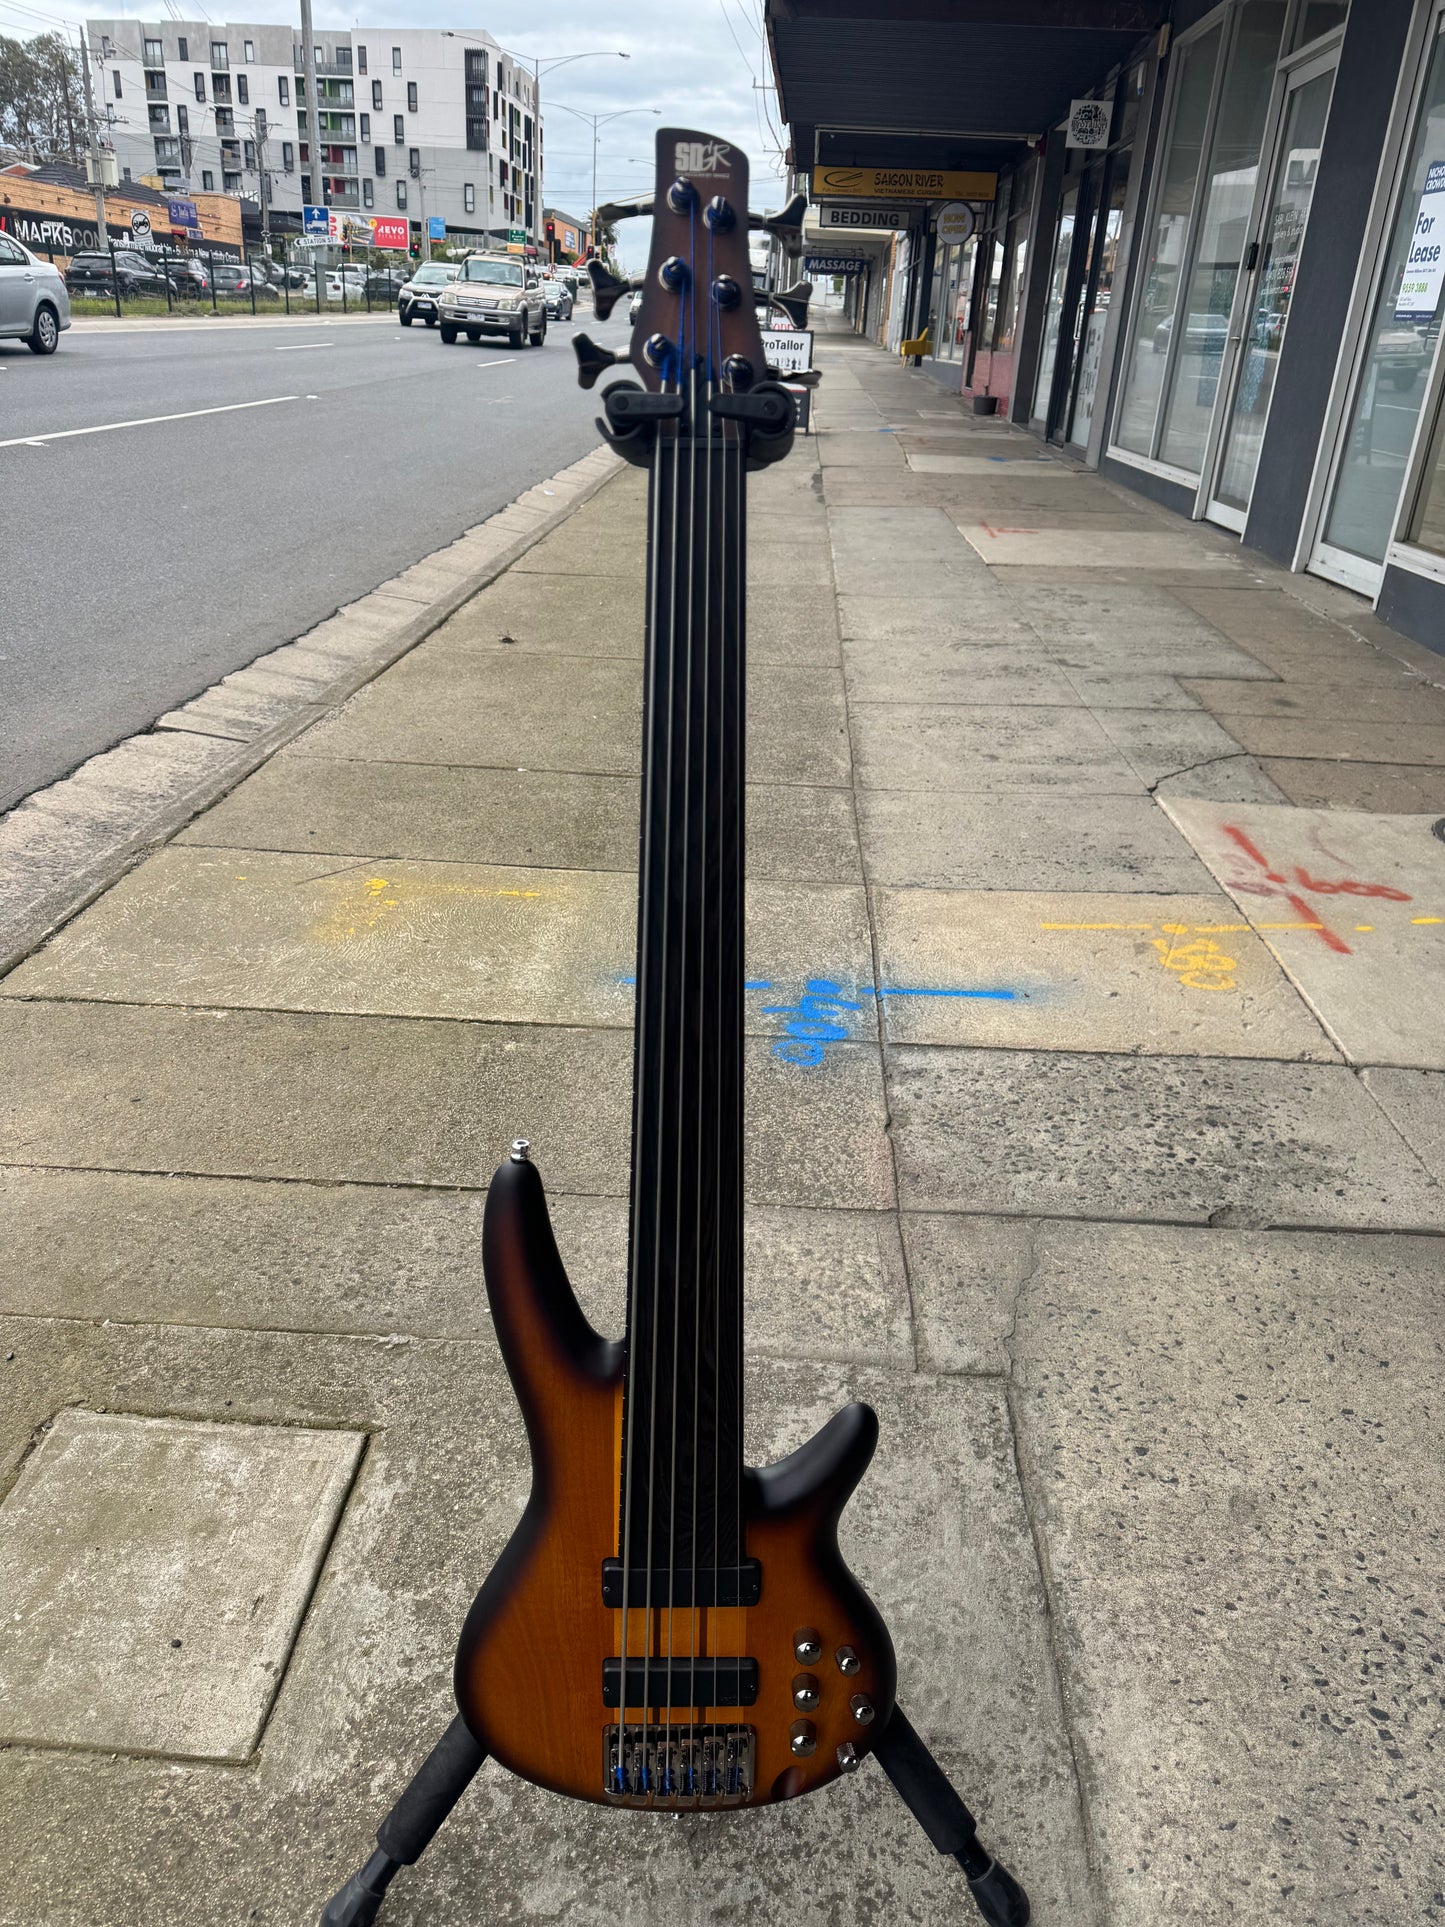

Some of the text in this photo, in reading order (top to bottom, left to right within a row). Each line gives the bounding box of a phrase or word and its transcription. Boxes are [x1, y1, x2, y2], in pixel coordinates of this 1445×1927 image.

[874, 172, 944, 188] SAIGON RIVER
[874, 188, 915, 196] VIETNAMESE
[830, 210, 900, 226] BEDDING
[1415, 211, 1436, 235] For
[303, 236, 326, 245] STATION
[1408, 241, 1441, 263] Lease
[808, 260, 861, 271] MASSAGE
